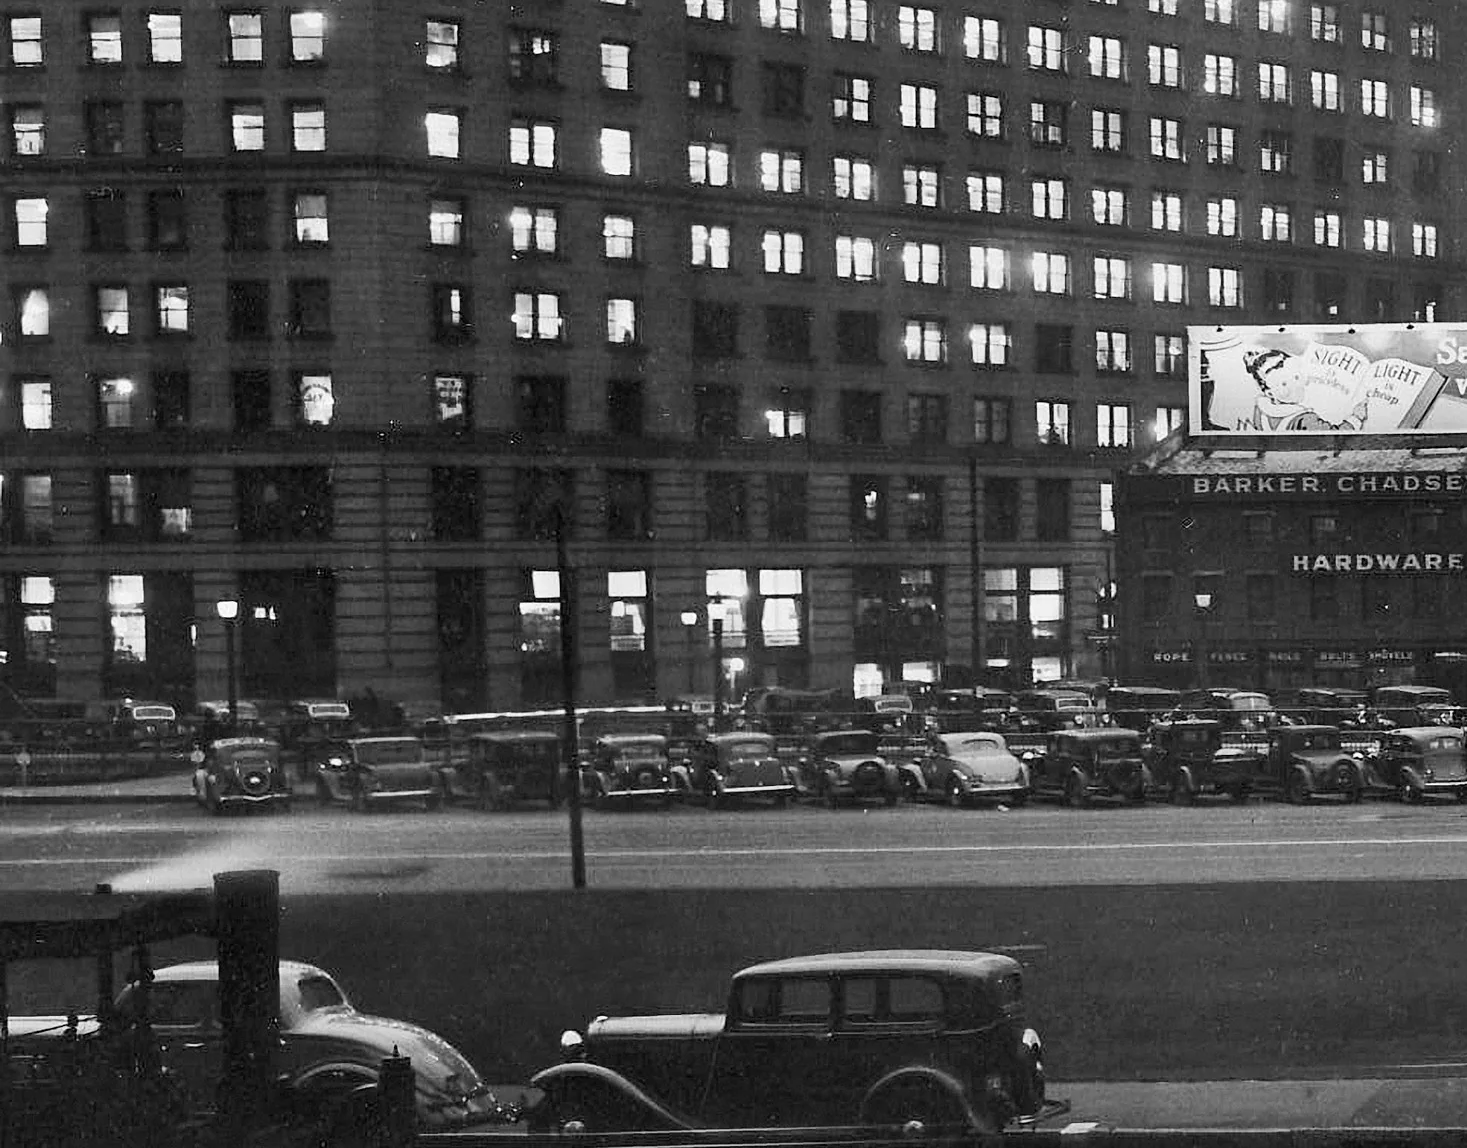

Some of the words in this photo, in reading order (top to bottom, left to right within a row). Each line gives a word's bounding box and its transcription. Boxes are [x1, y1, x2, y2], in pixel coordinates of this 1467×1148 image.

[1312, 349, 1361, 375] SIGHT
[1374, 363, 1421, 386] LIGHT
[1366, 388, 1400, 406] cheap
[1293, 553, 1465, 572] HARDWARE
